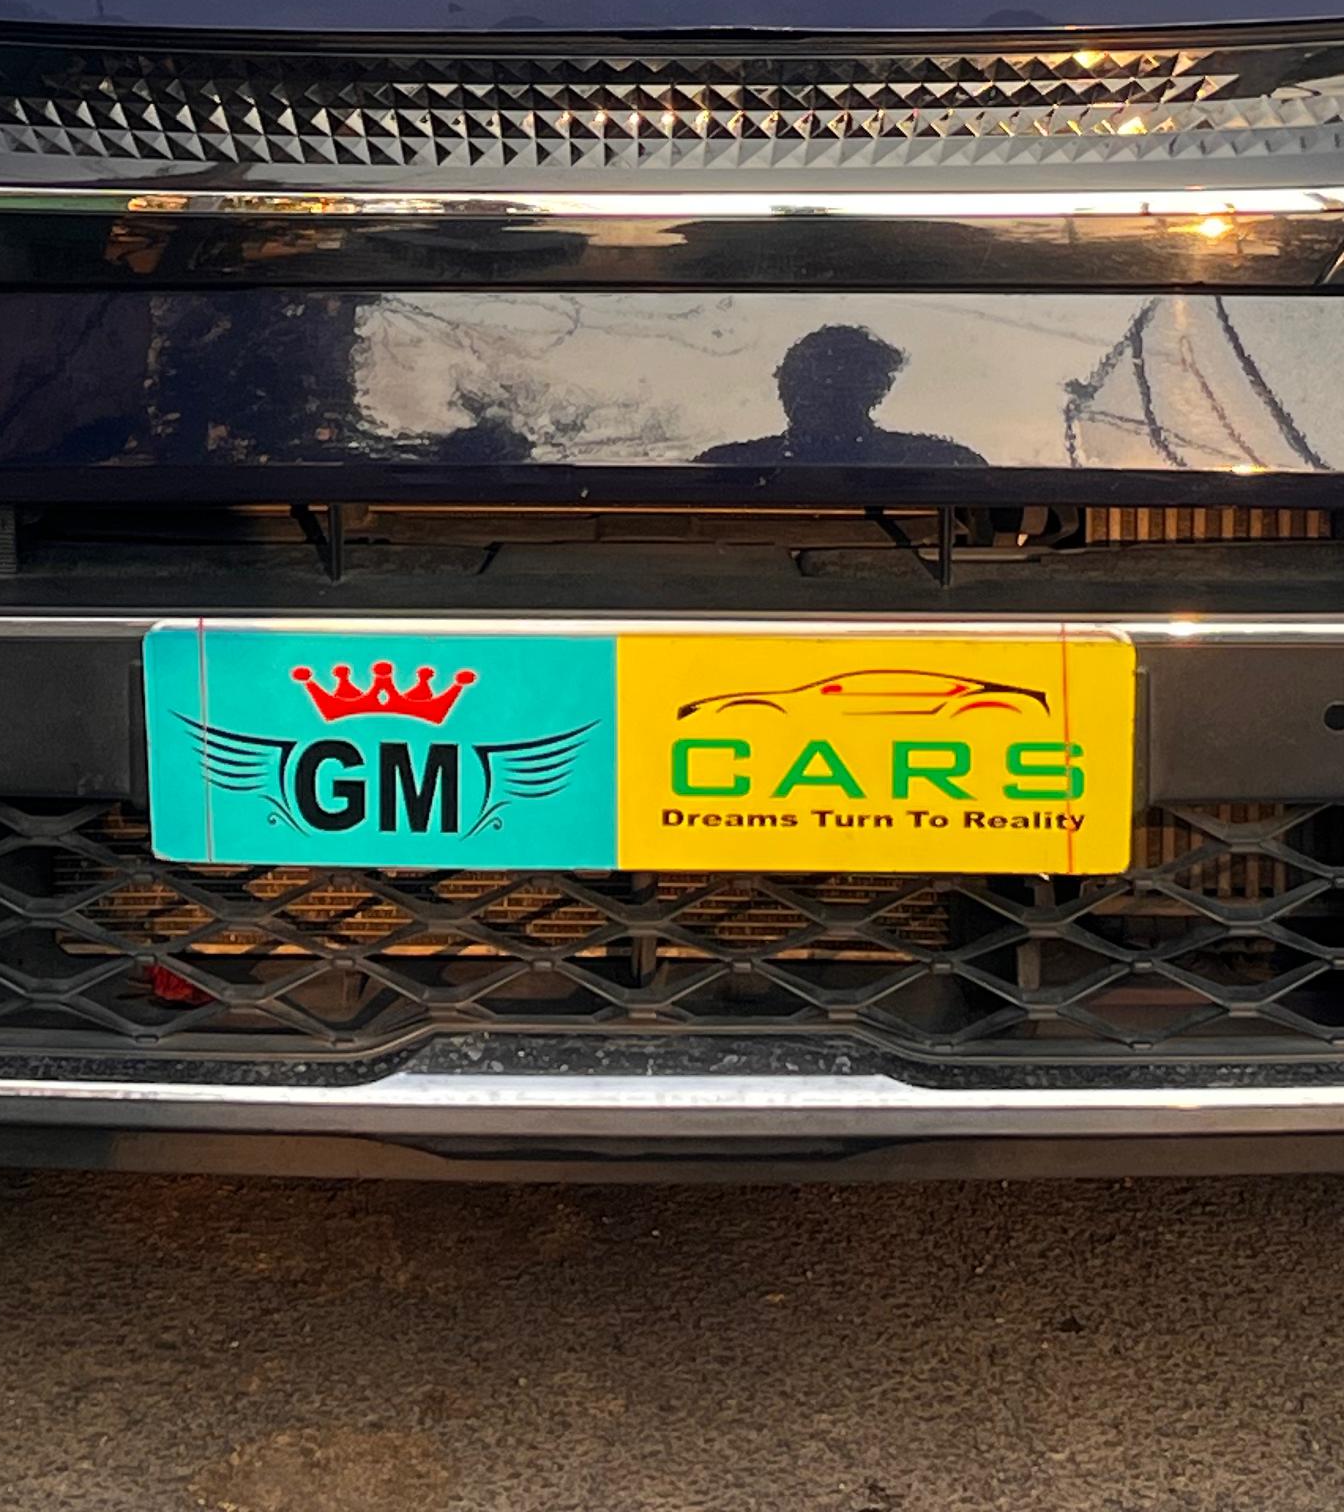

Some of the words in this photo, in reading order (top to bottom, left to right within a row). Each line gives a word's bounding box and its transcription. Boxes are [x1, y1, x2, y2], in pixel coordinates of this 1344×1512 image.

[296, 740, 459, 834] GM
[671, 737, 1085, 801] CARS
[660, 809, 799, 829] Dreams
[810, 809, 894, 829] Turn
[906, 810, 949, 830] To
[962, 811, 1086, 832] Reality
